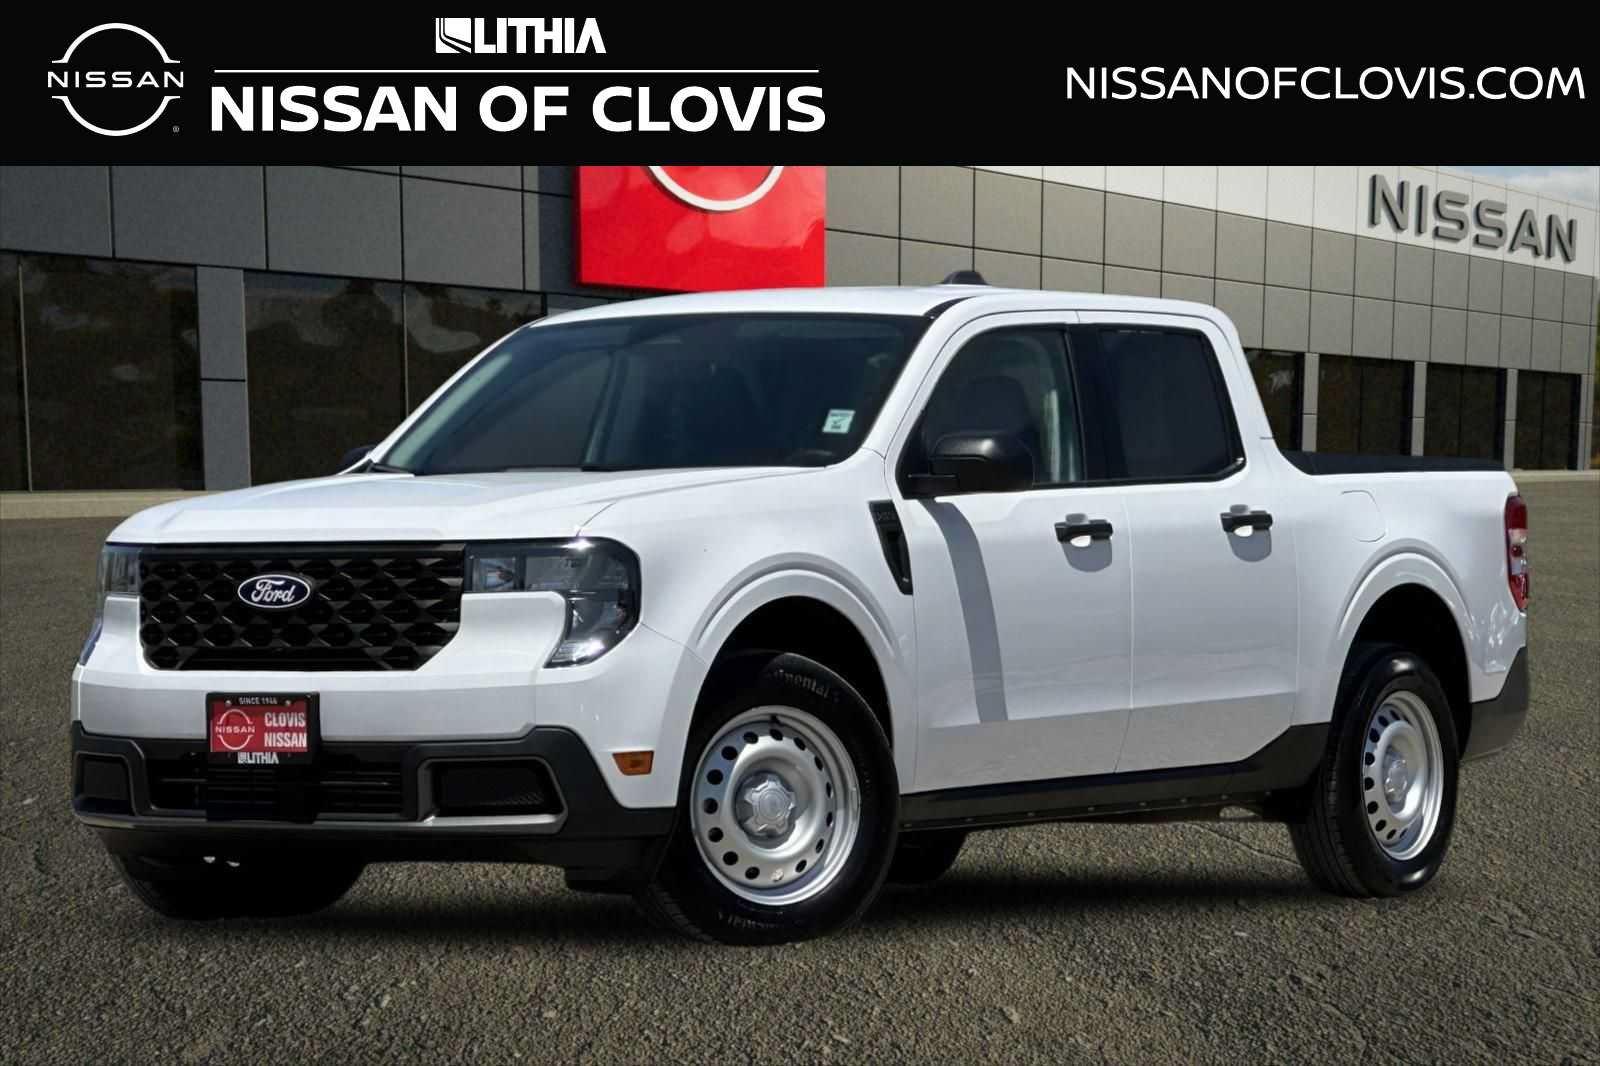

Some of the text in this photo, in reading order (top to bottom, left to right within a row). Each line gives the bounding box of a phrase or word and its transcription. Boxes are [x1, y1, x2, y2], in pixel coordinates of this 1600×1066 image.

[1368, 174, 1578, 263] NISSAN
[251, 579, 296, 602] Ford
[239, 697, 260, 705] SINCE
[264, 712, 306, 728] CLOVIS
[215, 725, 256, 733] NISSAN
[264, 732, 308, 748] NISSAN
[247, 751, 279, 764] LITHIA
